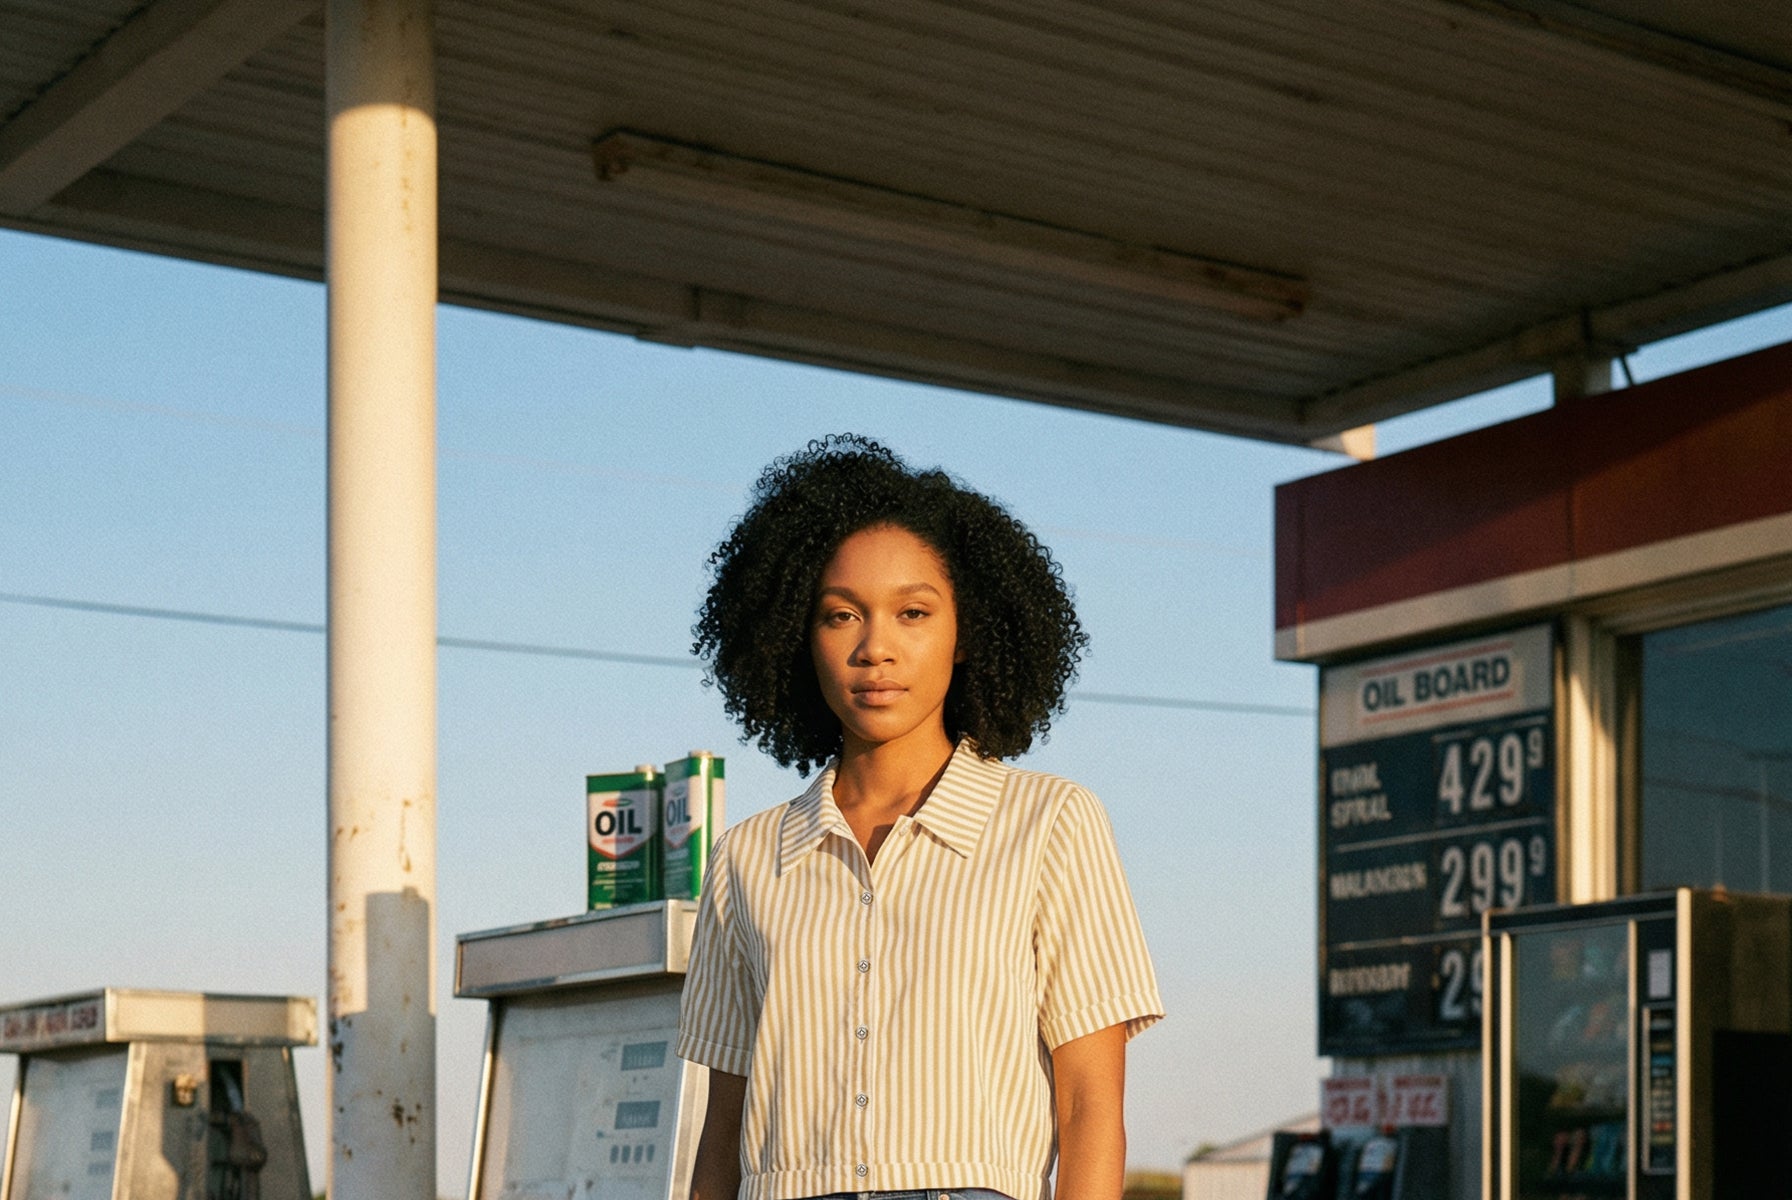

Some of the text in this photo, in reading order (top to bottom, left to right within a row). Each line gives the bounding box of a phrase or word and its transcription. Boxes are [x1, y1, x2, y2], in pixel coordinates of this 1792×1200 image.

[1363, 656, 1510, 712] OIL BOARD
[594, 808, 643, 836] OIL
[665, 797, 692, 827] OIL
